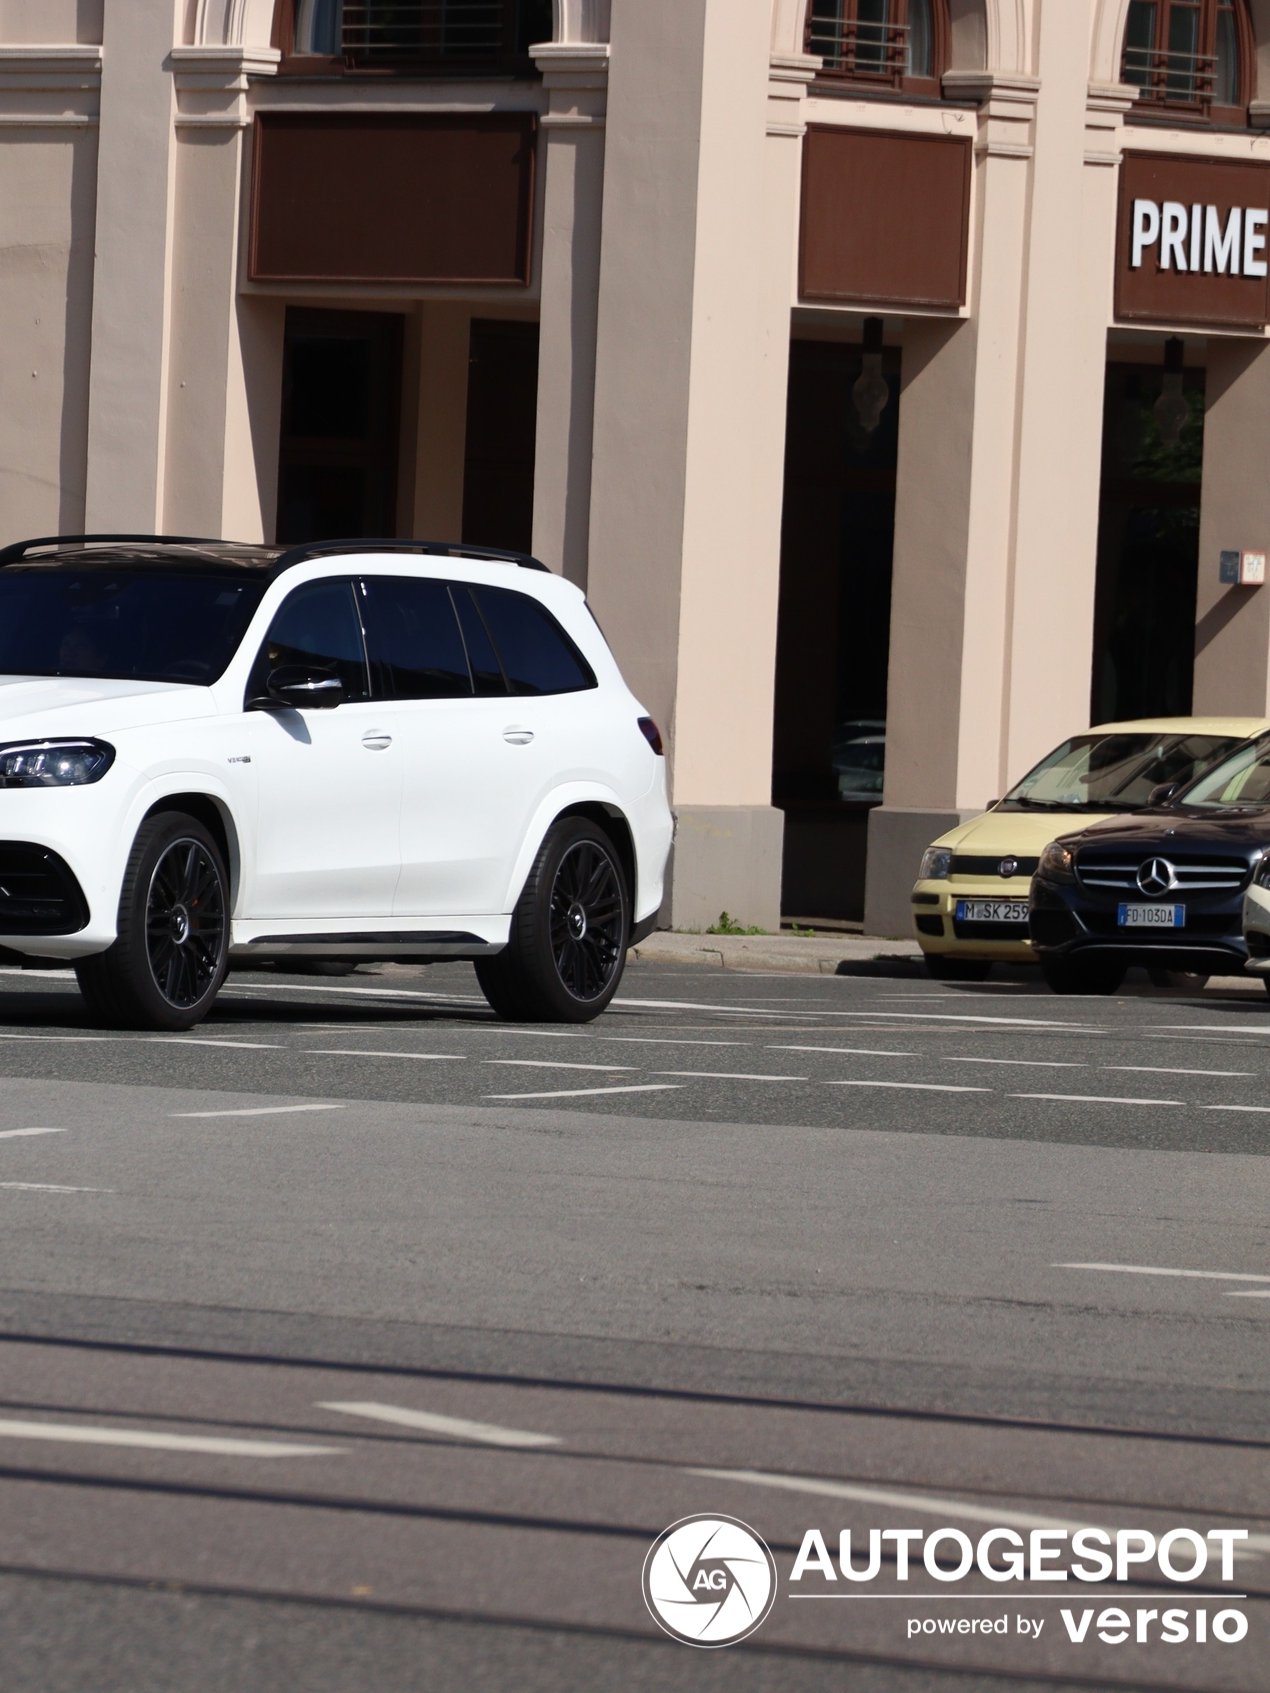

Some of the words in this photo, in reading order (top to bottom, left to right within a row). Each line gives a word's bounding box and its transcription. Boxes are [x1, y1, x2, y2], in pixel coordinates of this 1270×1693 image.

[1132, 198, 1269, 277] PRIME
[965, 903, 975, 919] M
[983, 904, 1001, 919] SK
